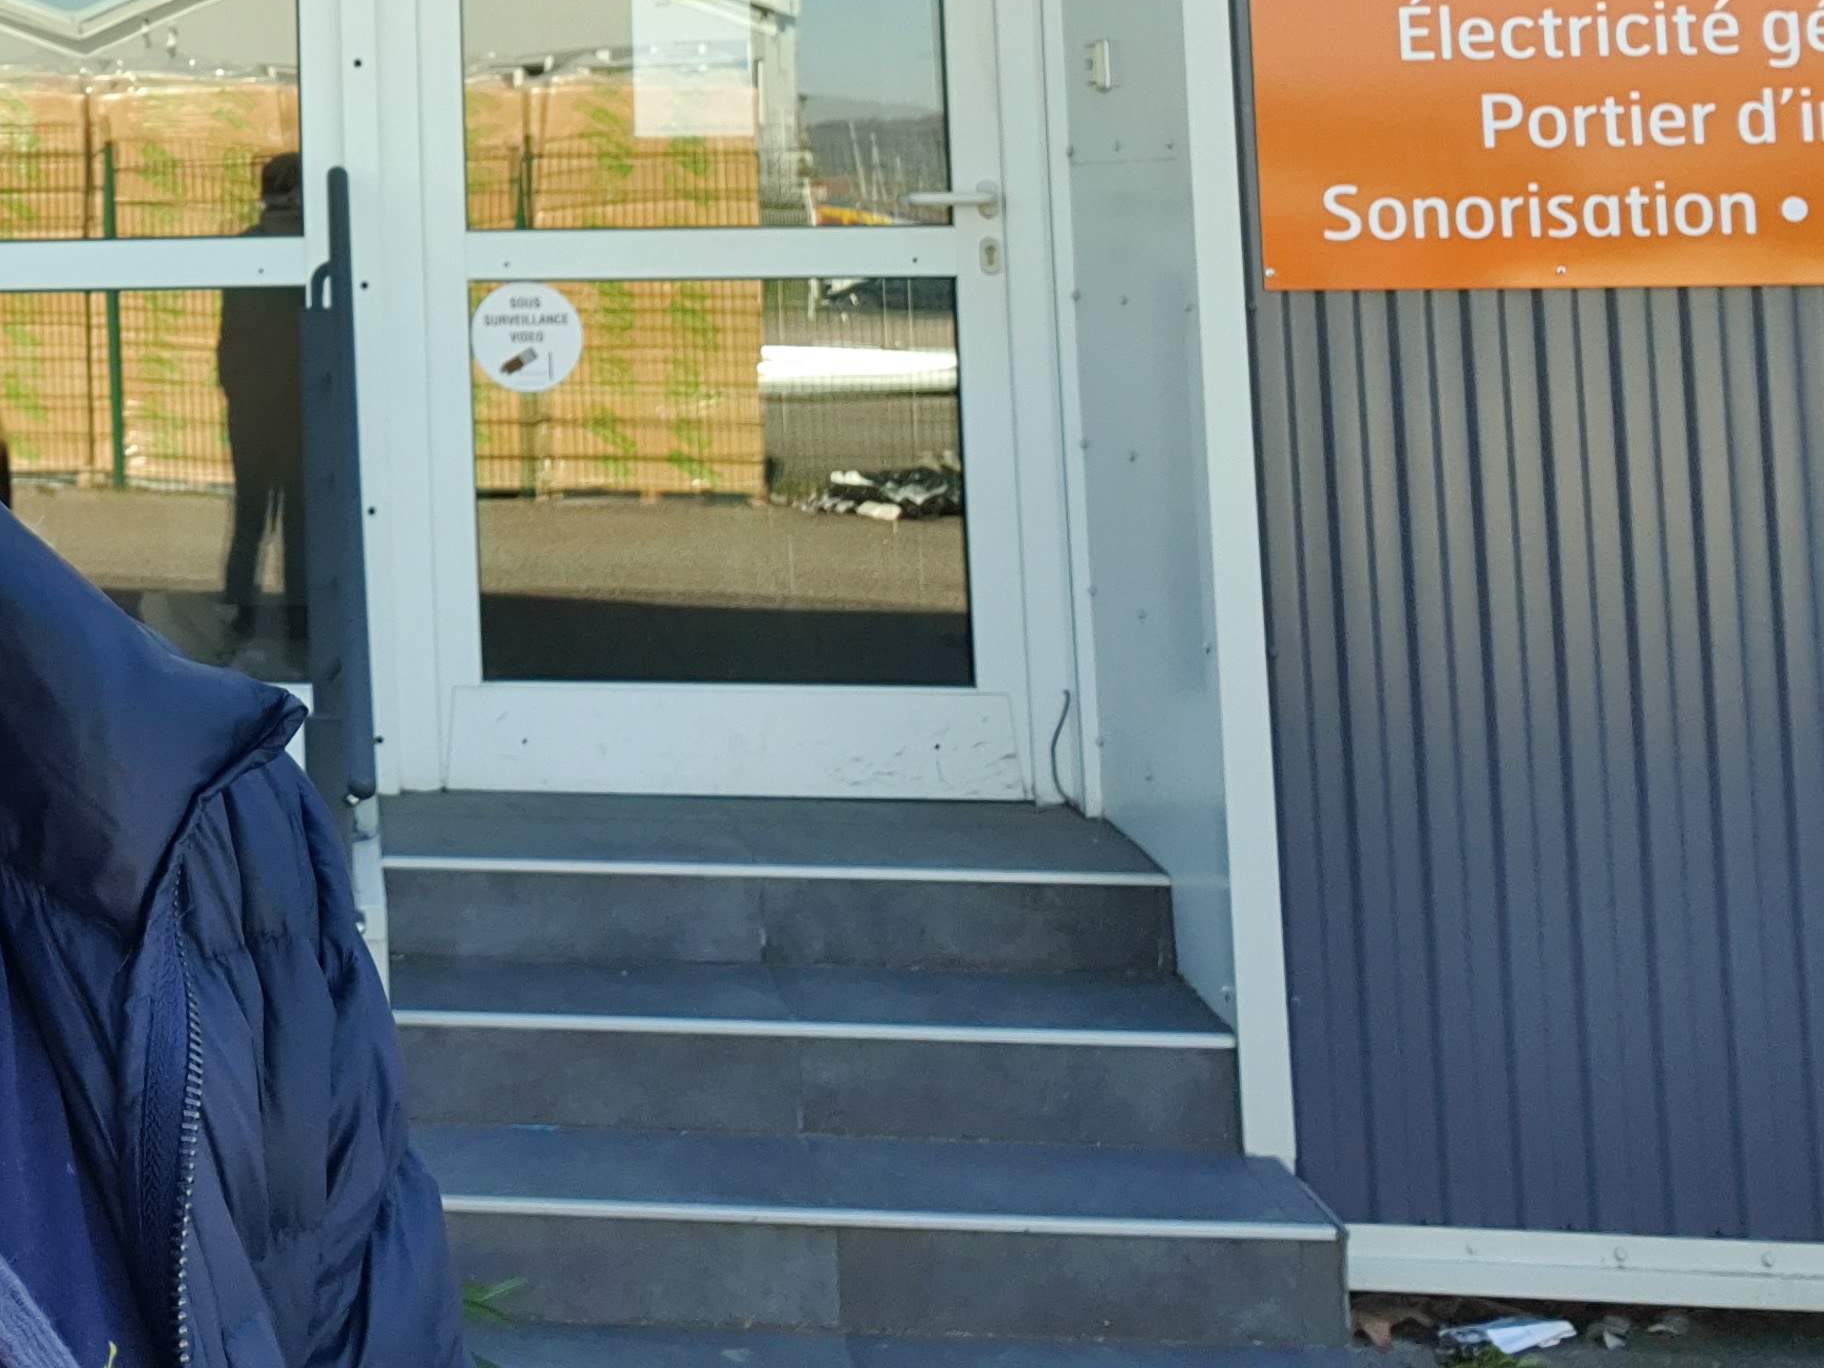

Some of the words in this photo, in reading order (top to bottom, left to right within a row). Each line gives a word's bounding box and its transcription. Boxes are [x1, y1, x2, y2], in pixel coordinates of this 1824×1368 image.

[1481, 91, 1716, 149] Portier
[1737, 87, 1824, 145] d’i
[1322, 181, 1758, 242] Sonorisation
[483, 313, 568, 326] SURVEILLANCE
[509, 297, 541, 308] SOUS
